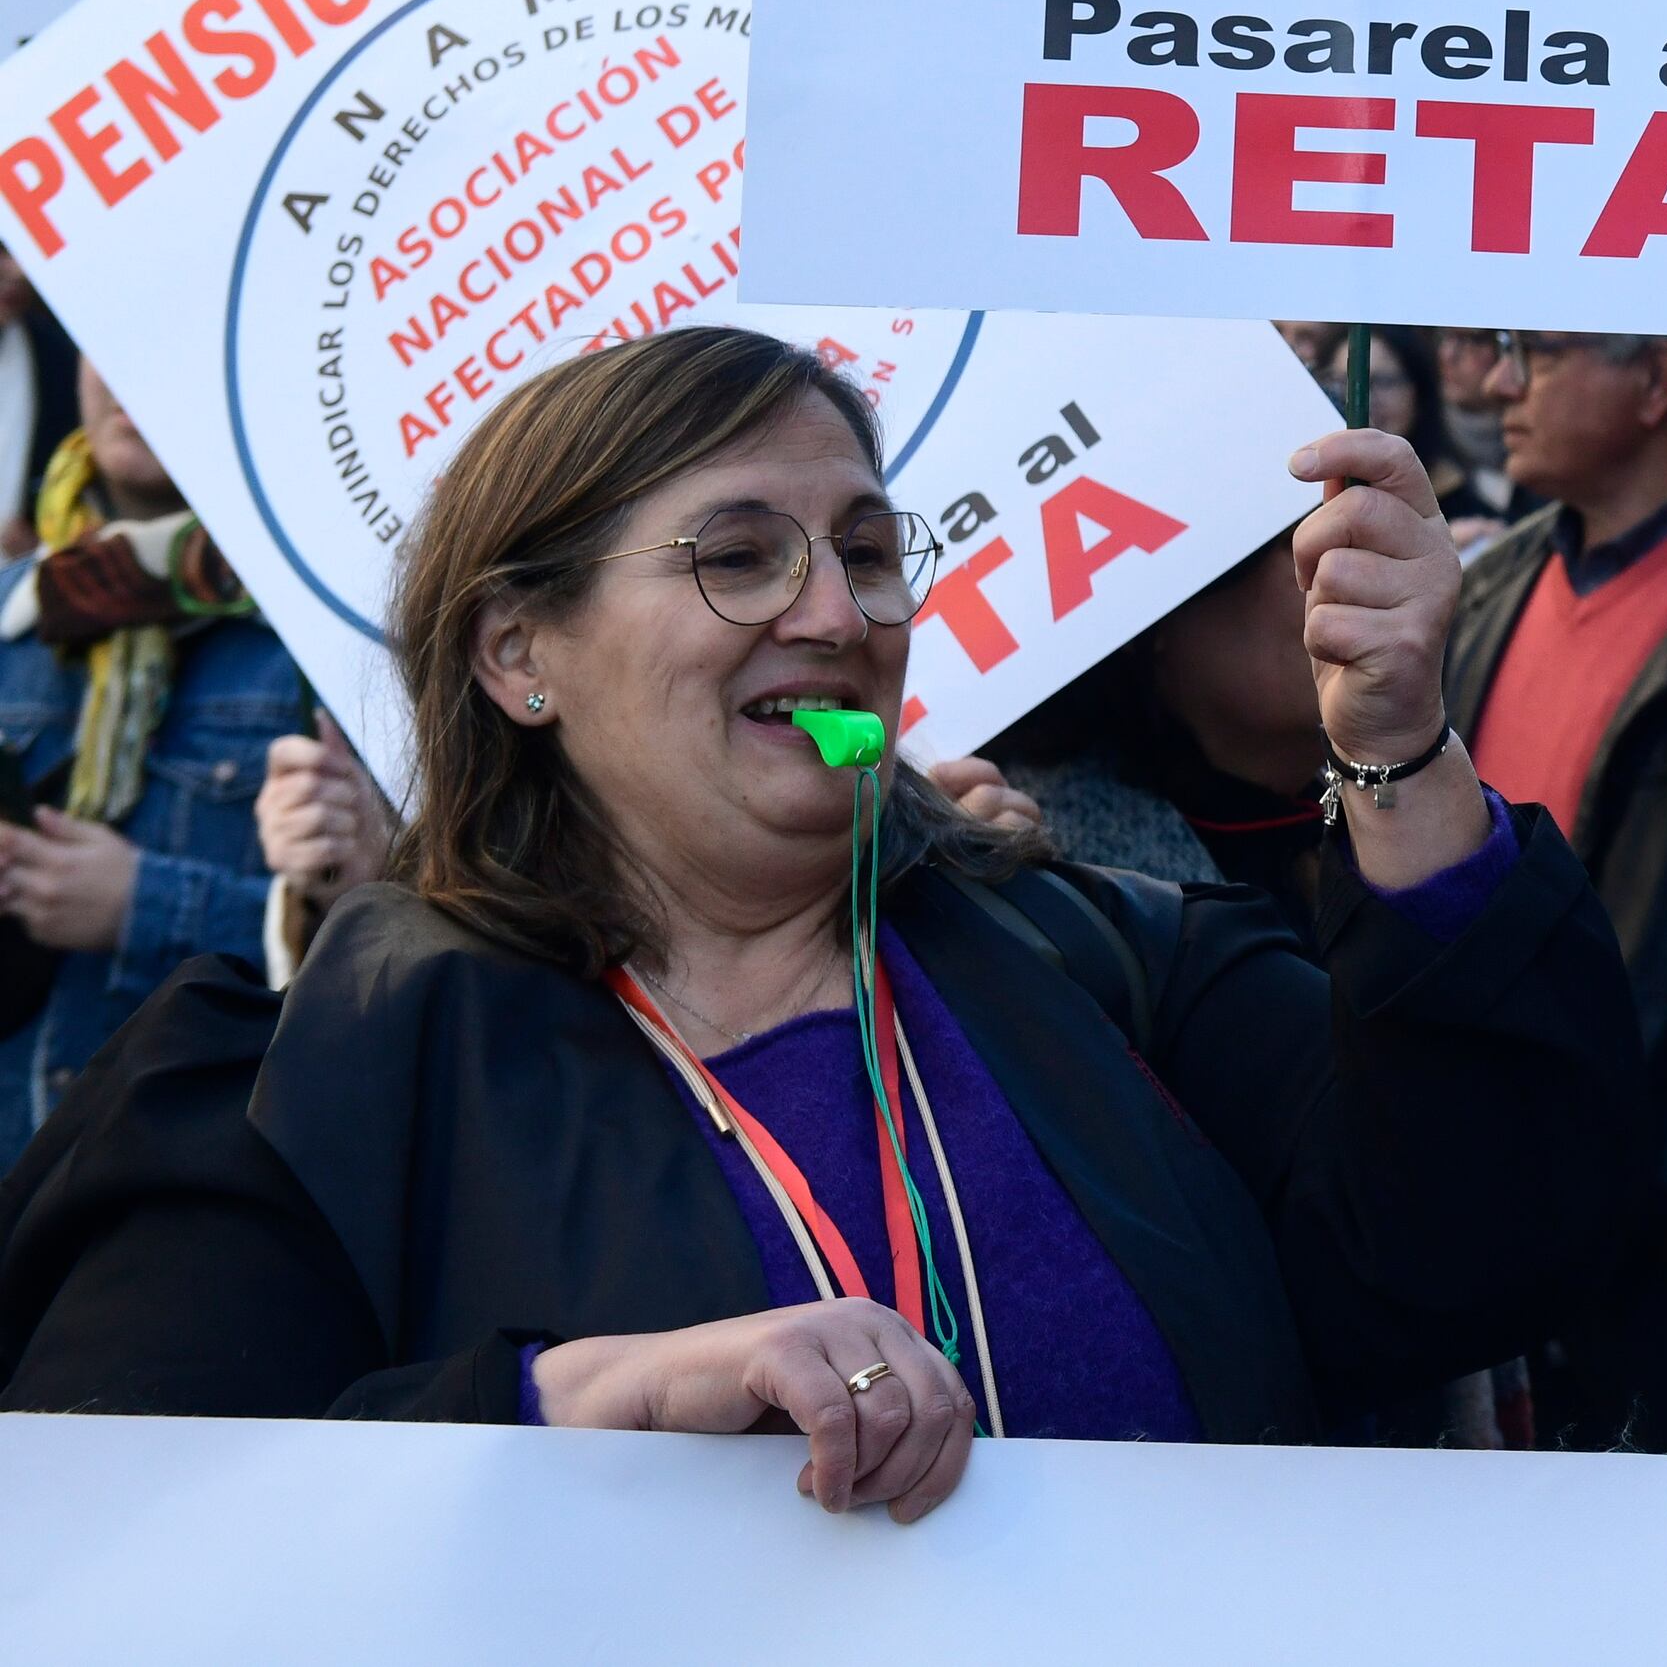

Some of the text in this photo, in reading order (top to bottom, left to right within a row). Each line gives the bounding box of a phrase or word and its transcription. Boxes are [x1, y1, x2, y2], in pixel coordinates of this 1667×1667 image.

[318, 5, 688, 543] EIVINDICAR LOS DERECHOS DE LOS
[370, 37, 681, 300] ASOCIACIÓN
[388, 148, 653, 367] NACIONAL
[656, 78, 736, 148] DE
[399, 197, 687, 456] AFECTADOS
[1018, 401, 1101, 485] al
[900, 474, 1190, 739] TA
